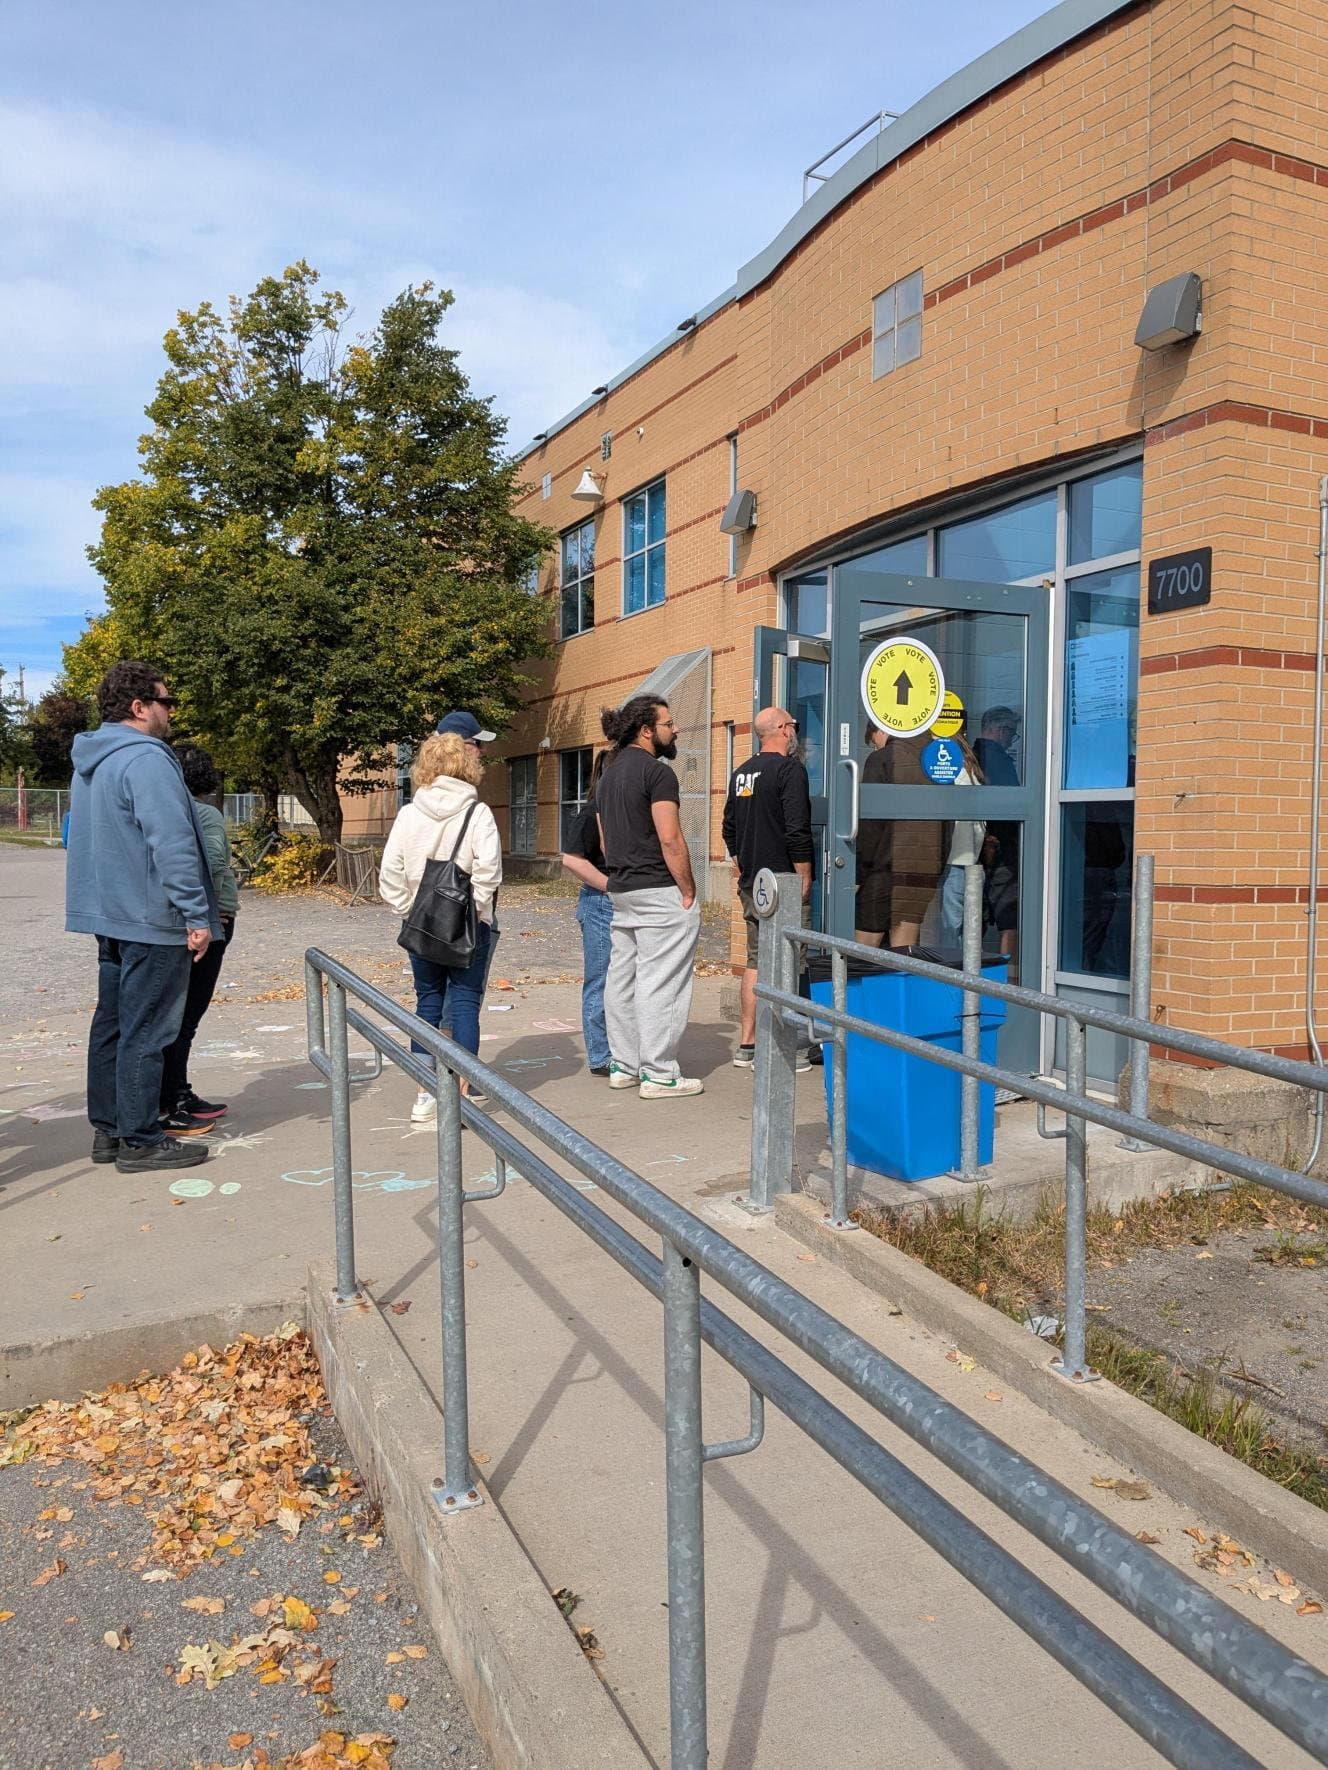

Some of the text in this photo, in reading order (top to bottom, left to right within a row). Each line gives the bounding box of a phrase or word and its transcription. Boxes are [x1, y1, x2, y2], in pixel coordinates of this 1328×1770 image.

[1156, 561, 1203, 600] 7700
[877, 649, 895, 667] VOTE
[905, 647, 926, 663] VOTE
[870, 678, 878, 704] VOTE
[928, 671, 937, 696] VOTE
[882, 712, 903, 727] VOTE
[912, 707, 931, 725] VOTE
[736, 771, 761, 797] CAT
